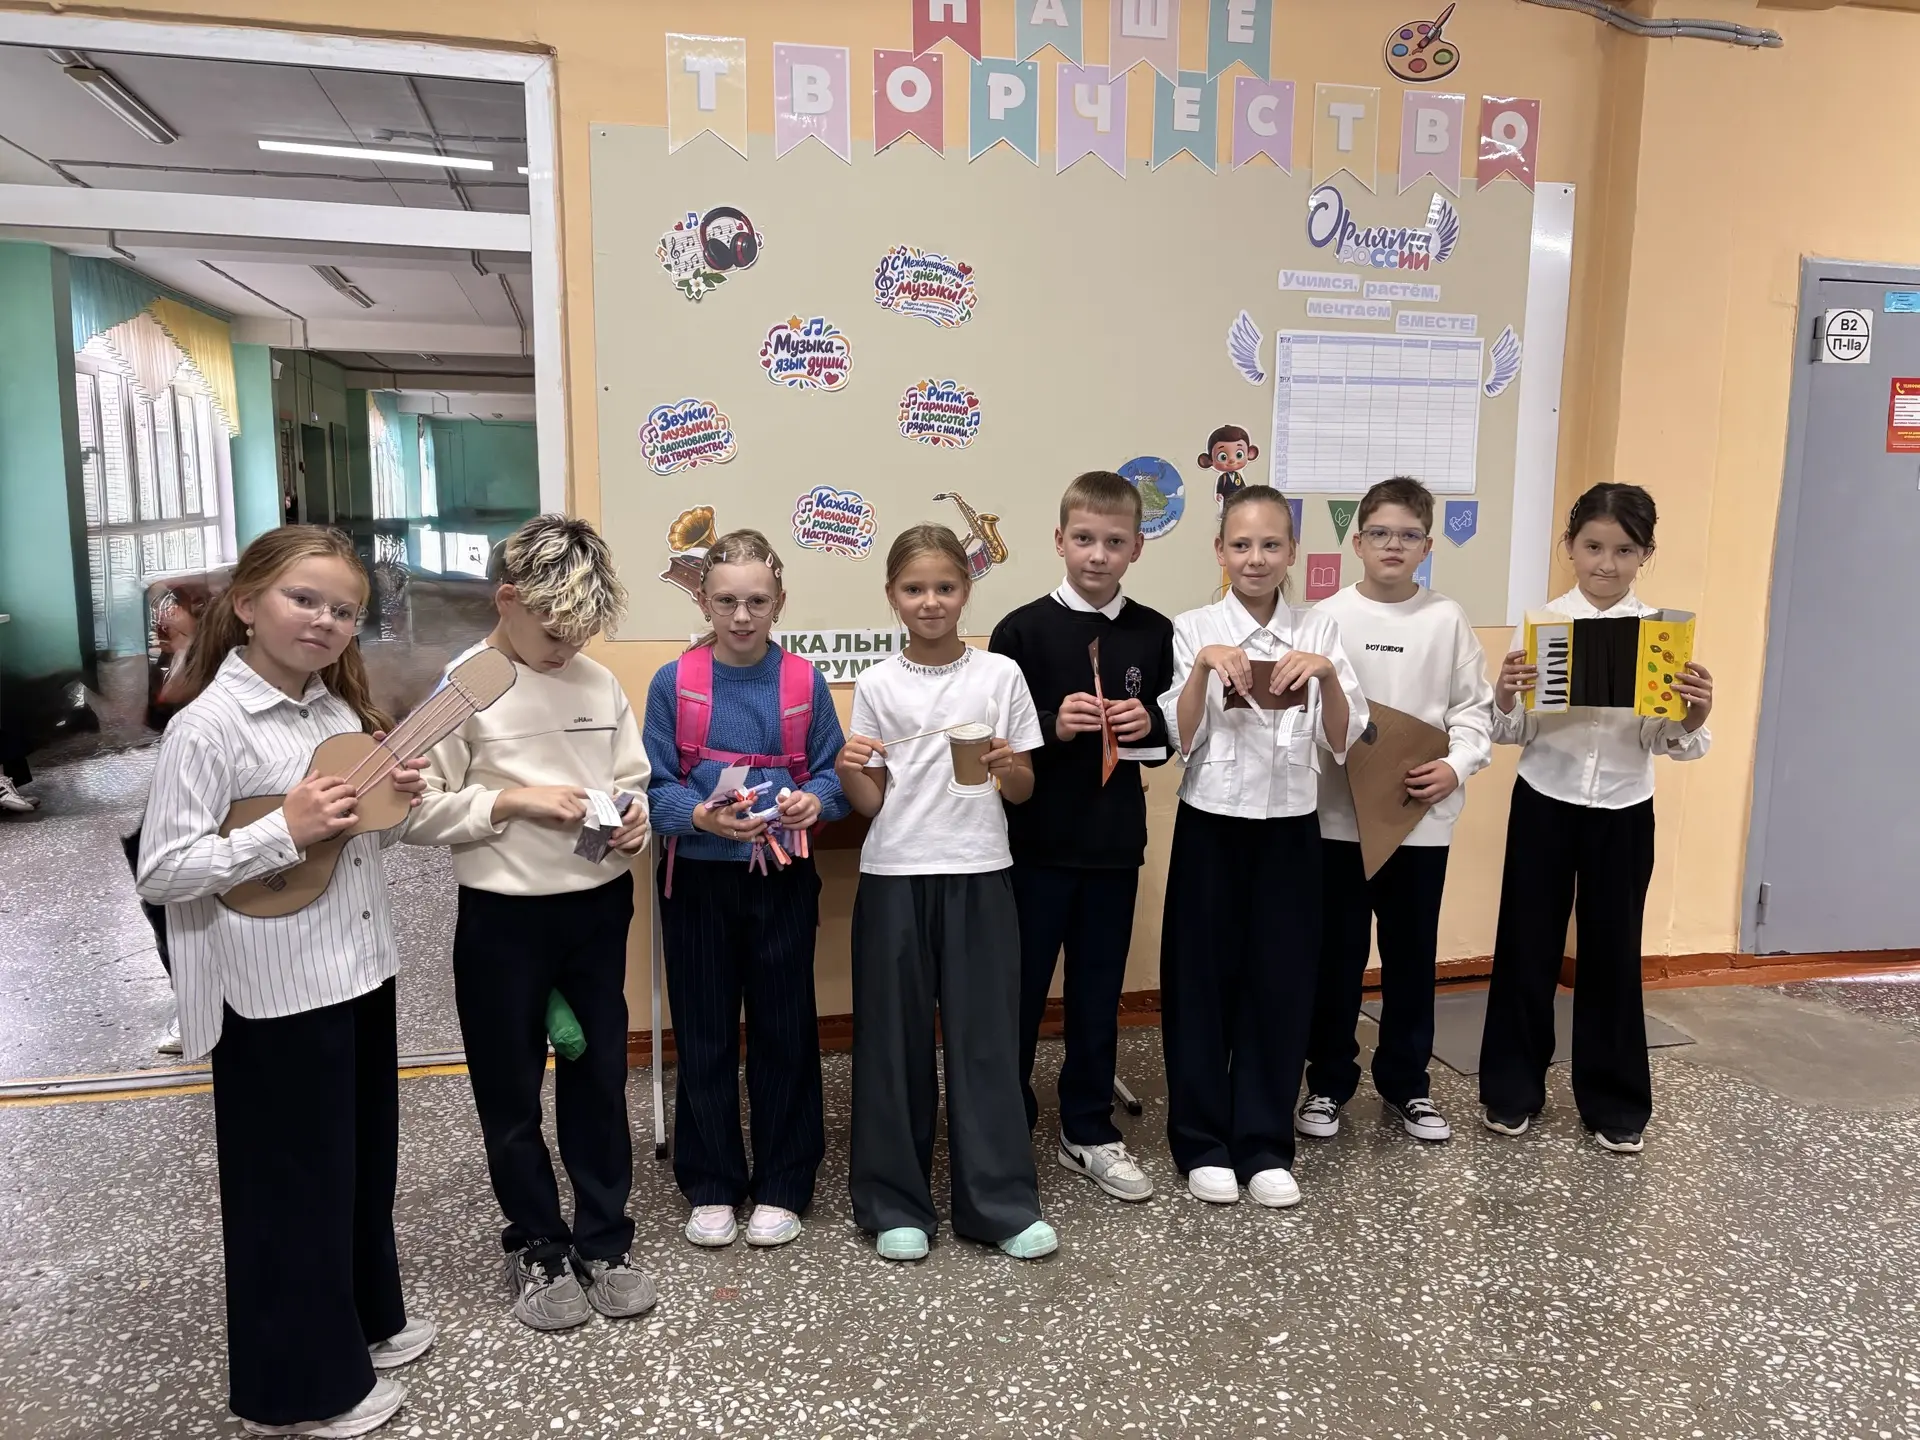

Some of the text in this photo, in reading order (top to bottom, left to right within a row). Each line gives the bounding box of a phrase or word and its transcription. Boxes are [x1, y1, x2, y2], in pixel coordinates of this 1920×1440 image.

[901, 255, 964, 282] Международным
[912, 268, 942, 284] днём
[1283, 271, 1439, 299] Учимся, растём,
[1308, 301, 1390, 318] мечтаем
[774, 356, 848, 377] язык души.
[926, 386, 965, 405] Ритм,
[916, 401, 969, 416] гармония
[911, 412, 966, 428] и красота
[906, 421, 970, 439] рядом с нами.
[815, 492, 864, 516] Каждая
[811, 519, 858, 536] рождает
[801, 527, 862, 550] Настроение.
